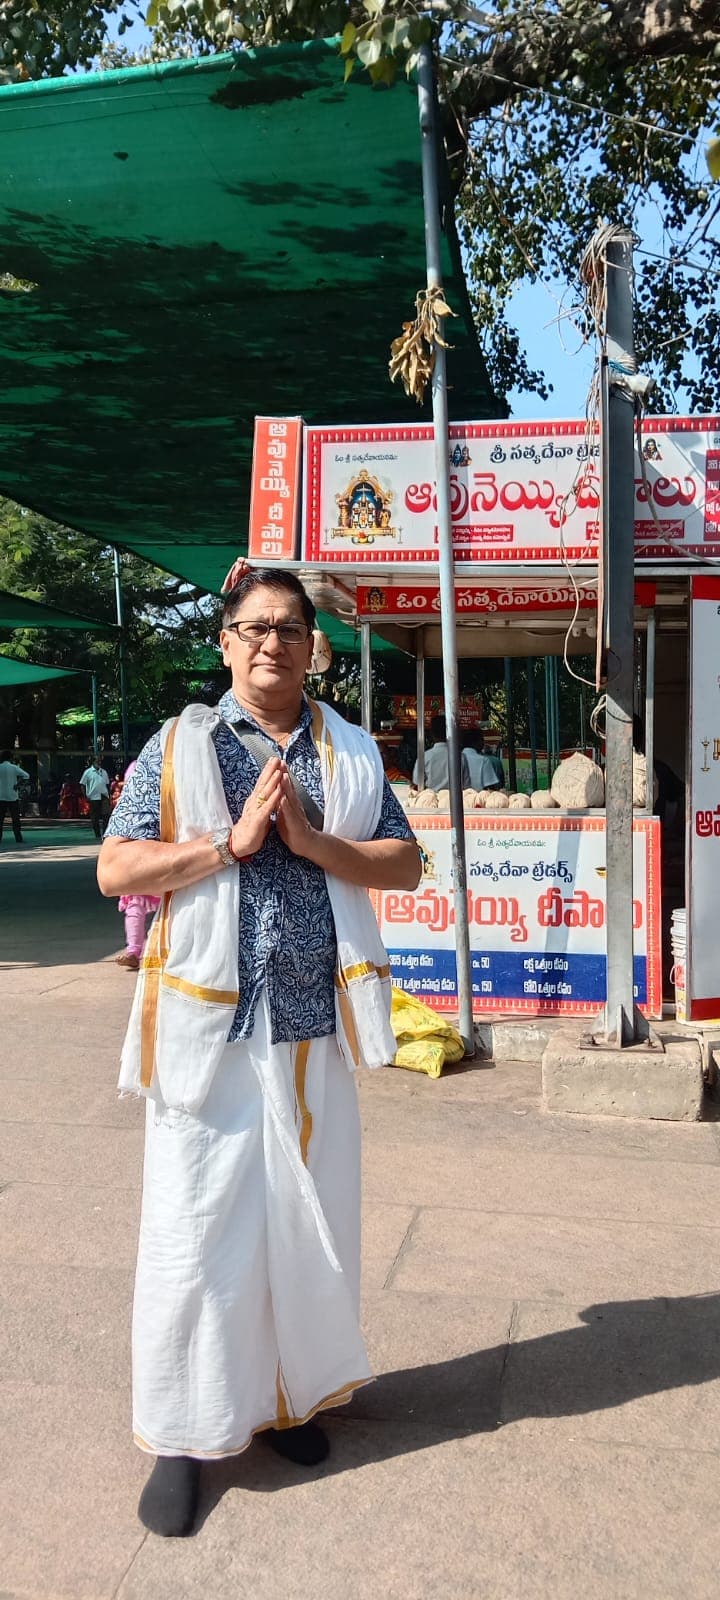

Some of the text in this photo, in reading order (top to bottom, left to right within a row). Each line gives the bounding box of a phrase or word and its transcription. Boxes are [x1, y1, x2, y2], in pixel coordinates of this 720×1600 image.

[490, 442, 600, 464] శ్రీ సత్యదేవా ట్రేడ
[575, 463, 697, 509] దీలు
[396, 592, 427, 609] ఓం
[457, 586, 598, 611] సత్యదేవాయనమ
[470, 860, 529, 882] సత్యదేవా
[532, 860, 573, 883] ట్రేడర్స్
[537, 887, 643, 929] దీపా
[481, 957, 490, 968] 50
